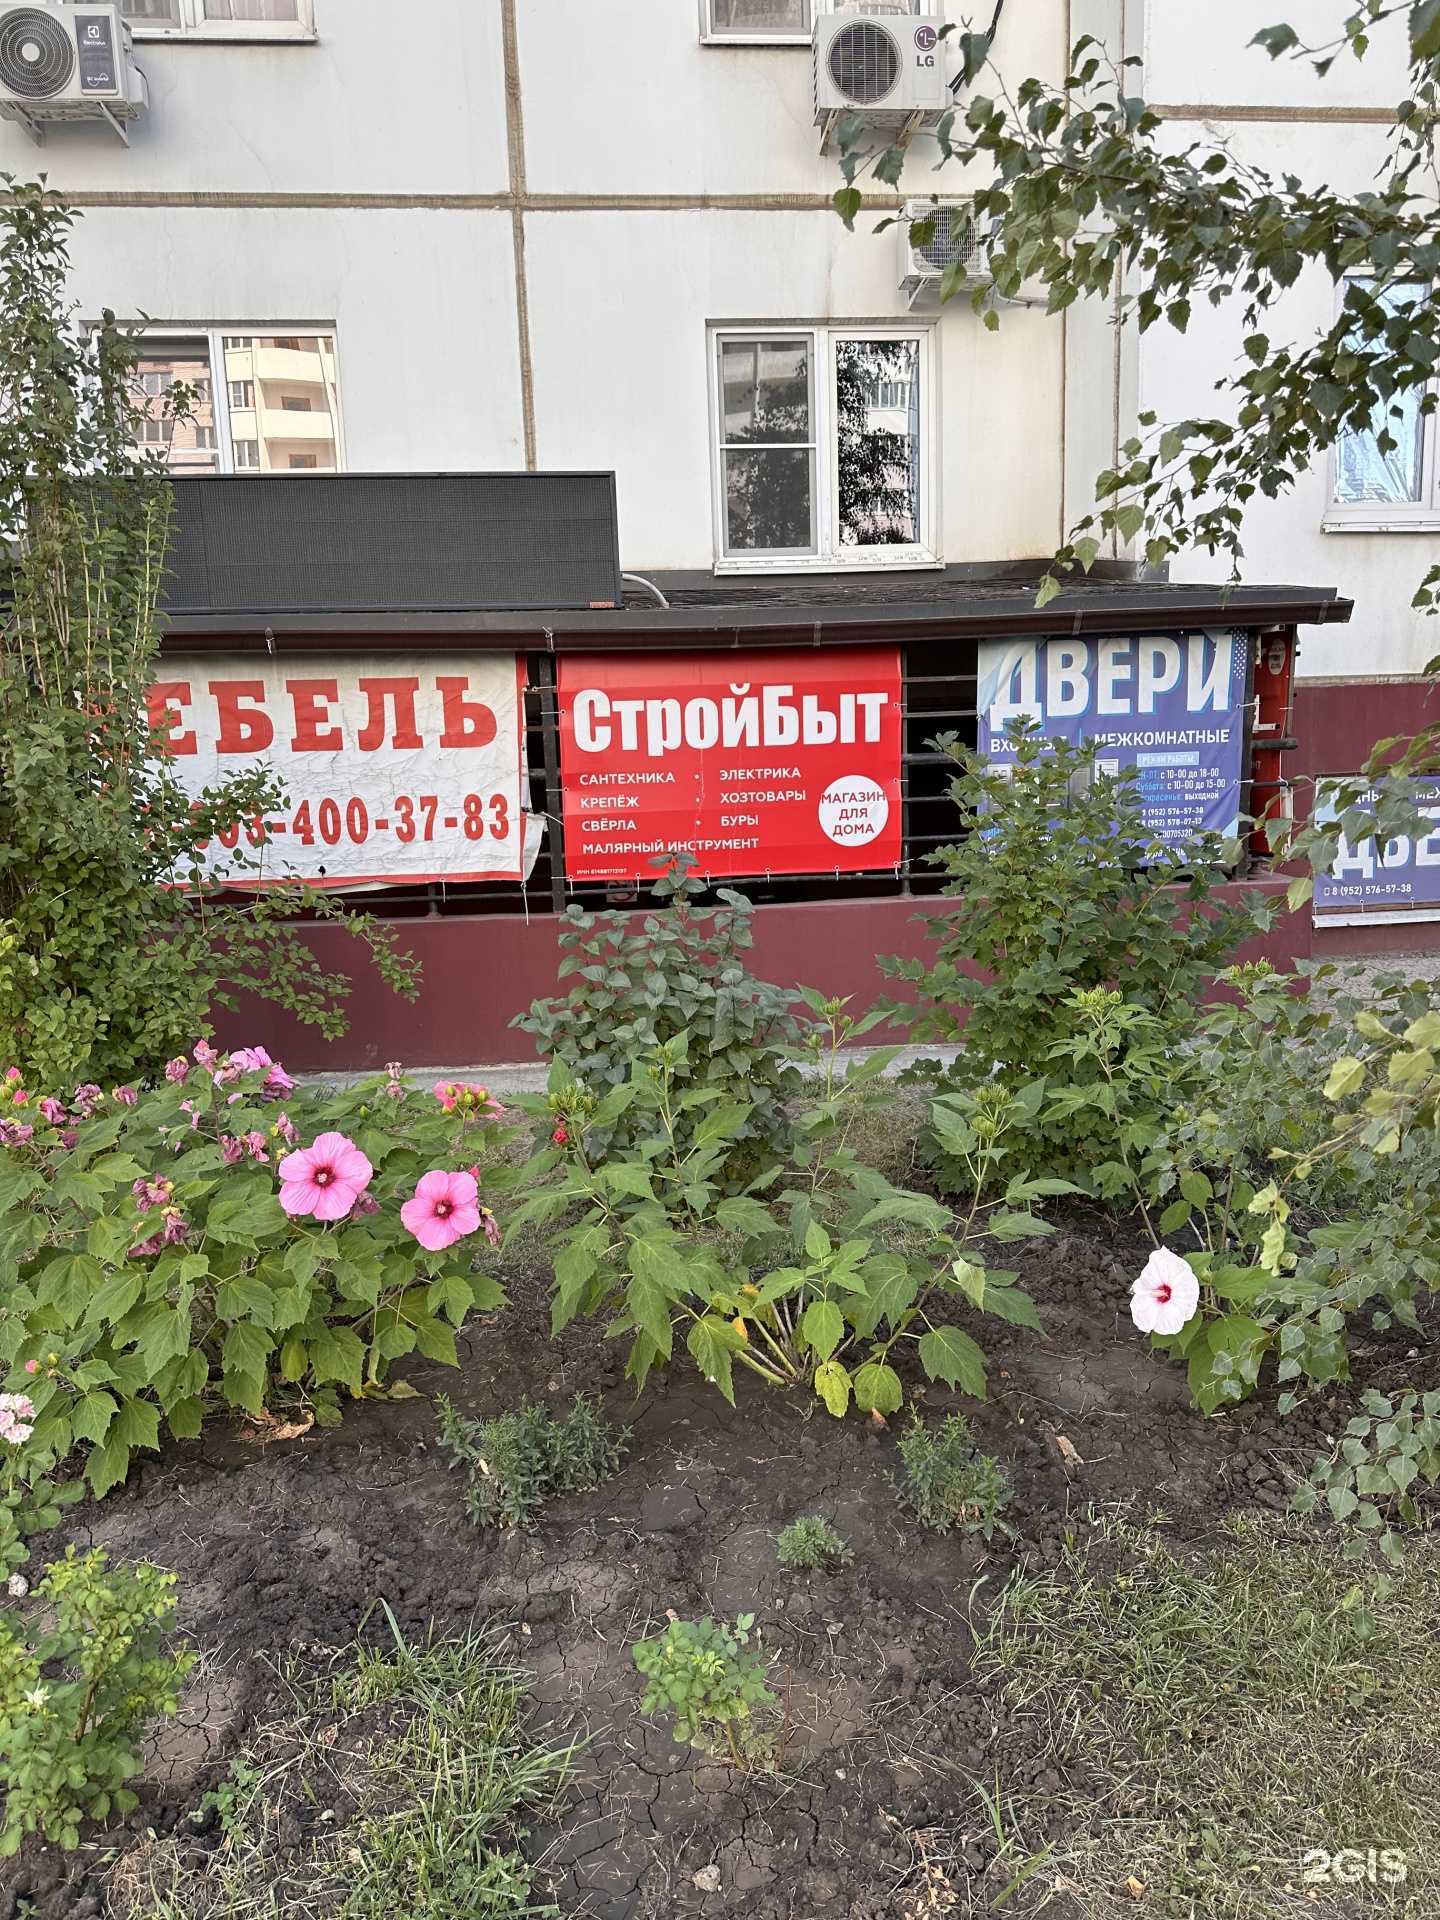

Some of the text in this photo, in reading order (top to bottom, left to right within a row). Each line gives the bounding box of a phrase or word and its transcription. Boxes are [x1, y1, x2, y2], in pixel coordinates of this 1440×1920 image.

[916, 55, 935, 67] LG
[990, 634, 1232, 732] ДВЕРИ
[83, 677, 498, 757] ЕБЕЛЬ
[573, 682, 889, 757] СтройБыт
[1094, 729, 1230, 747] МЕЖКОМНАТНЫЕ
[579, 771, 676, 786] САНТЕХНИКА
[719, 767, 802, 781] ЭЛЕКТРИКА
[1188, 771, 1198, 779] до
[1195, 782, 1205, 791] до
[580, 794, 639, 809] КРЕПЁЖ
[720, 790, 806, 805] ХОЗТОВАРЫ
[821, 791, 887, 805] МАГАЗИН
[1184, 790, 1219, 801] выходной
[720, 814, 759, 828] БУРЫ
[839, 807, 868, 821] ДЛЯ
[581, 817, 637, 832] СВЁРЛА
[833, 823, 875, 838] ДОМА
[582, 838, 759, 855] МАЛЯРНЫЙ ИНСТРУМЕНТ
[1331, 884, 1412, 897] 8 (952) 576-57-38
